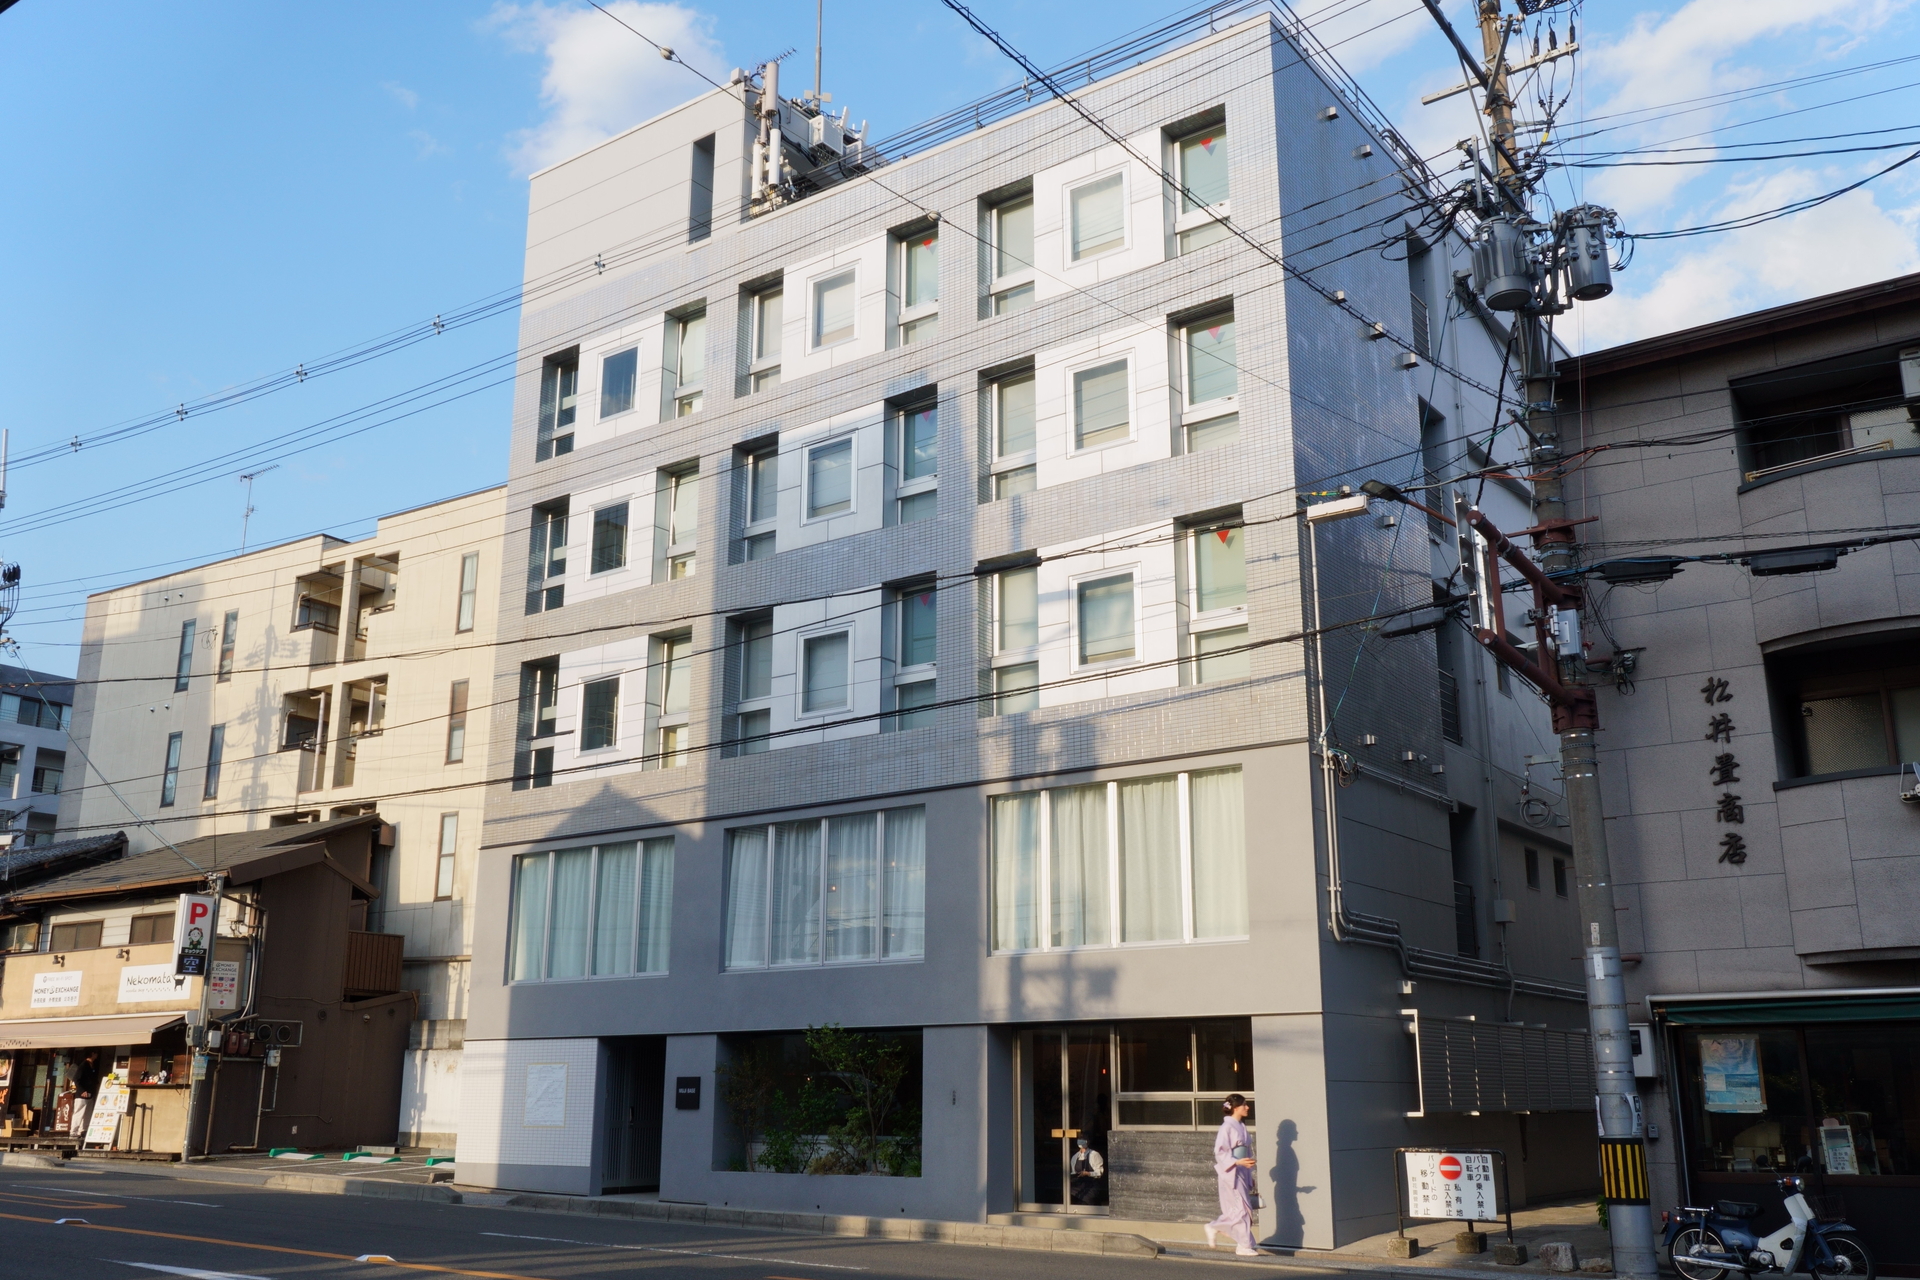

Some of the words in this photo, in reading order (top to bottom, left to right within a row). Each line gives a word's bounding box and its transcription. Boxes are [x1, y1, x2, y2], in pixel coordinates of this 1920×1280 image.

[1700, 676, 1747, 865] 松井畳商店
[189, 902, 209, 925] P
[182, 956, 200, 973] 空
[55, 985, 79, 994] EXCHANGE
[126, 972, 172, 986] Nekomata
[1428, 1155, 1438, 1201] バリケードの
[1465, 1155, 1474, 1181] 自転車
[1481, 1155, 1490, 1182] 自動車
[1420, 1169, 1431, 1216] 移動禁止
[1444, 1183, 1453, 1217] 立入禁止
[1454, 1183, 1463, 1217] 私有地
